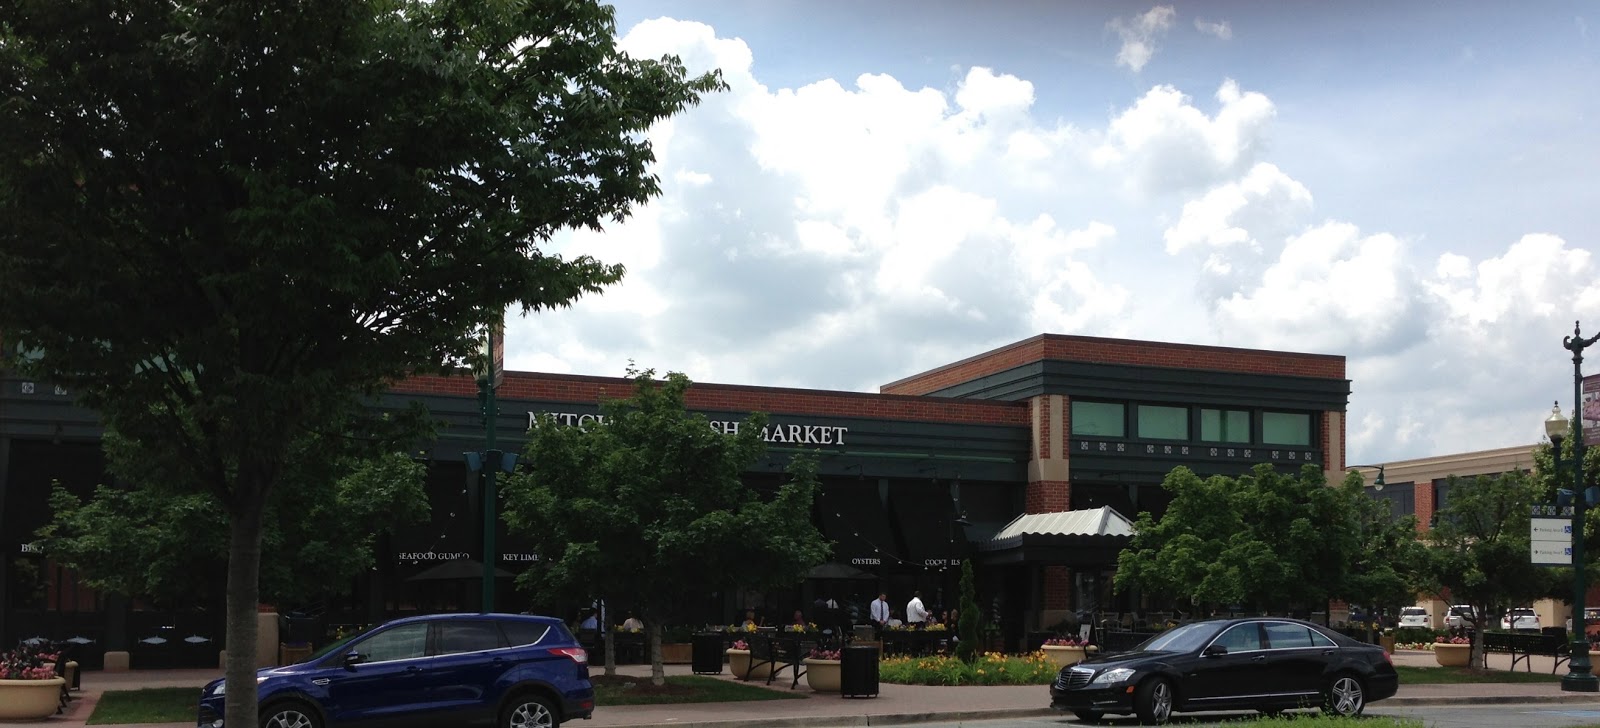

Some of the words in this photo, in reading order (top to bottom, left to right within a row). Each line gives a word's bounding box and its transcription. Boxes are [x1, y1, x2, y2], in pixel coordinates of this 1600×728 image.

[757, 423, 848, 446] MARKET
[398, 552, 437, 560] SEAFOOD
[502, 553, 519, 561] KEY
[924, 558, 961, 566] COCKTILS
